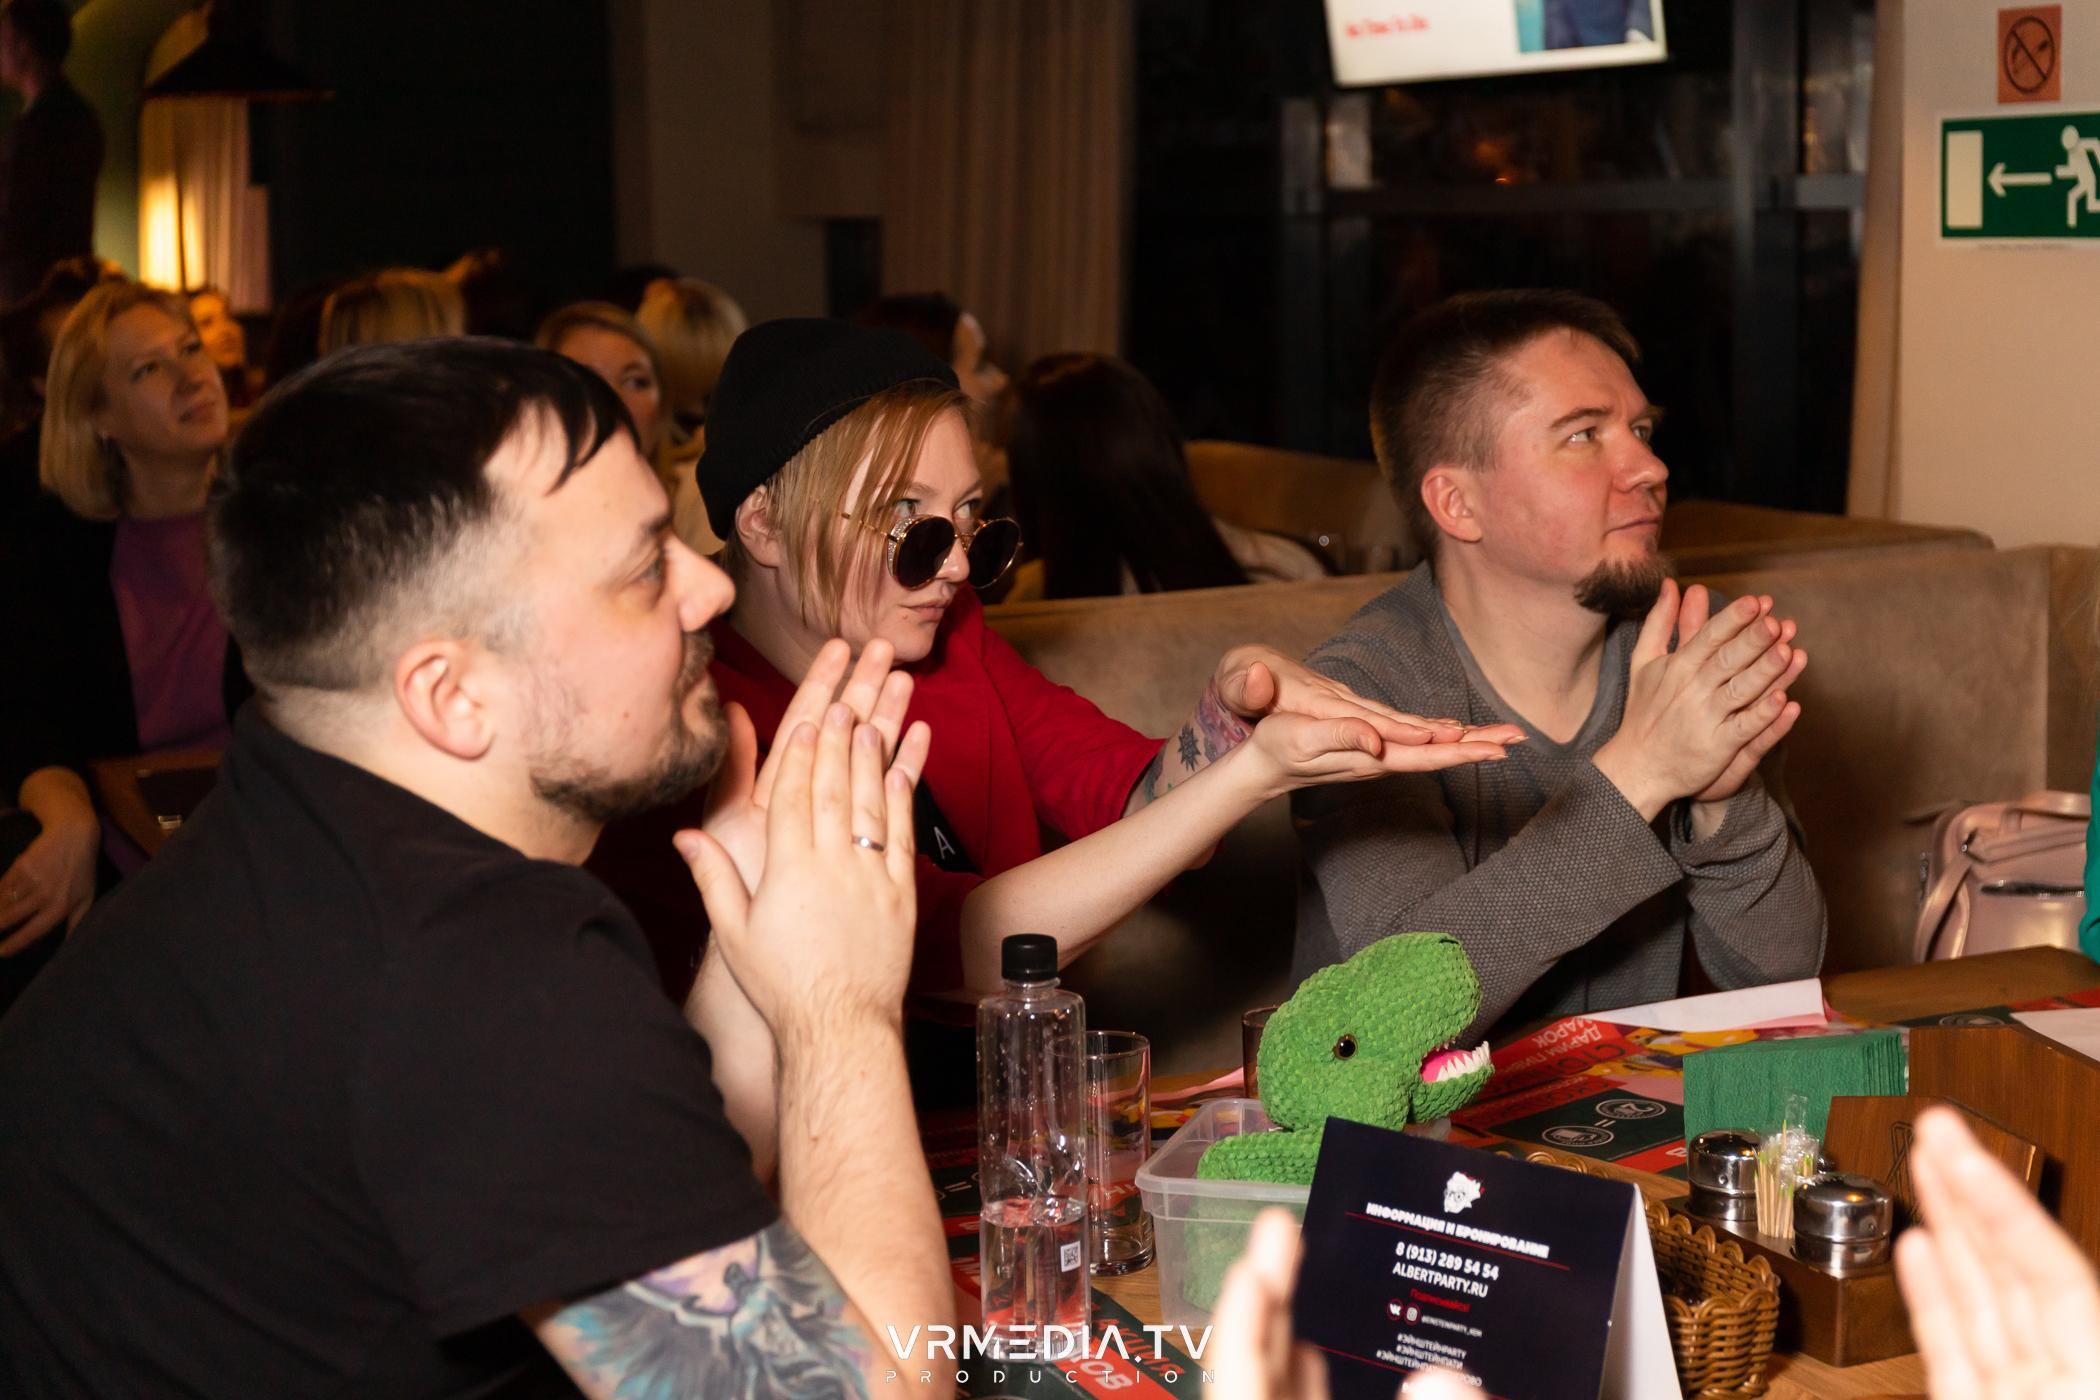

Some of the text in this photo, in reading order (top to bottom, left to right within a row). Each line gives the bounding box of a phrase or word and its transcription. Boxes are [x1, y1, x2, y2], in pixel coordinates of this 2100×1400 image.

[1546, 1023, 1602, 1057] ДАРИМ
[1395, 1241, 1500, 1281] 8 (913) 289 54 54
[1392, 1262, 1489, 1298] ALBERTPARTY.RU
